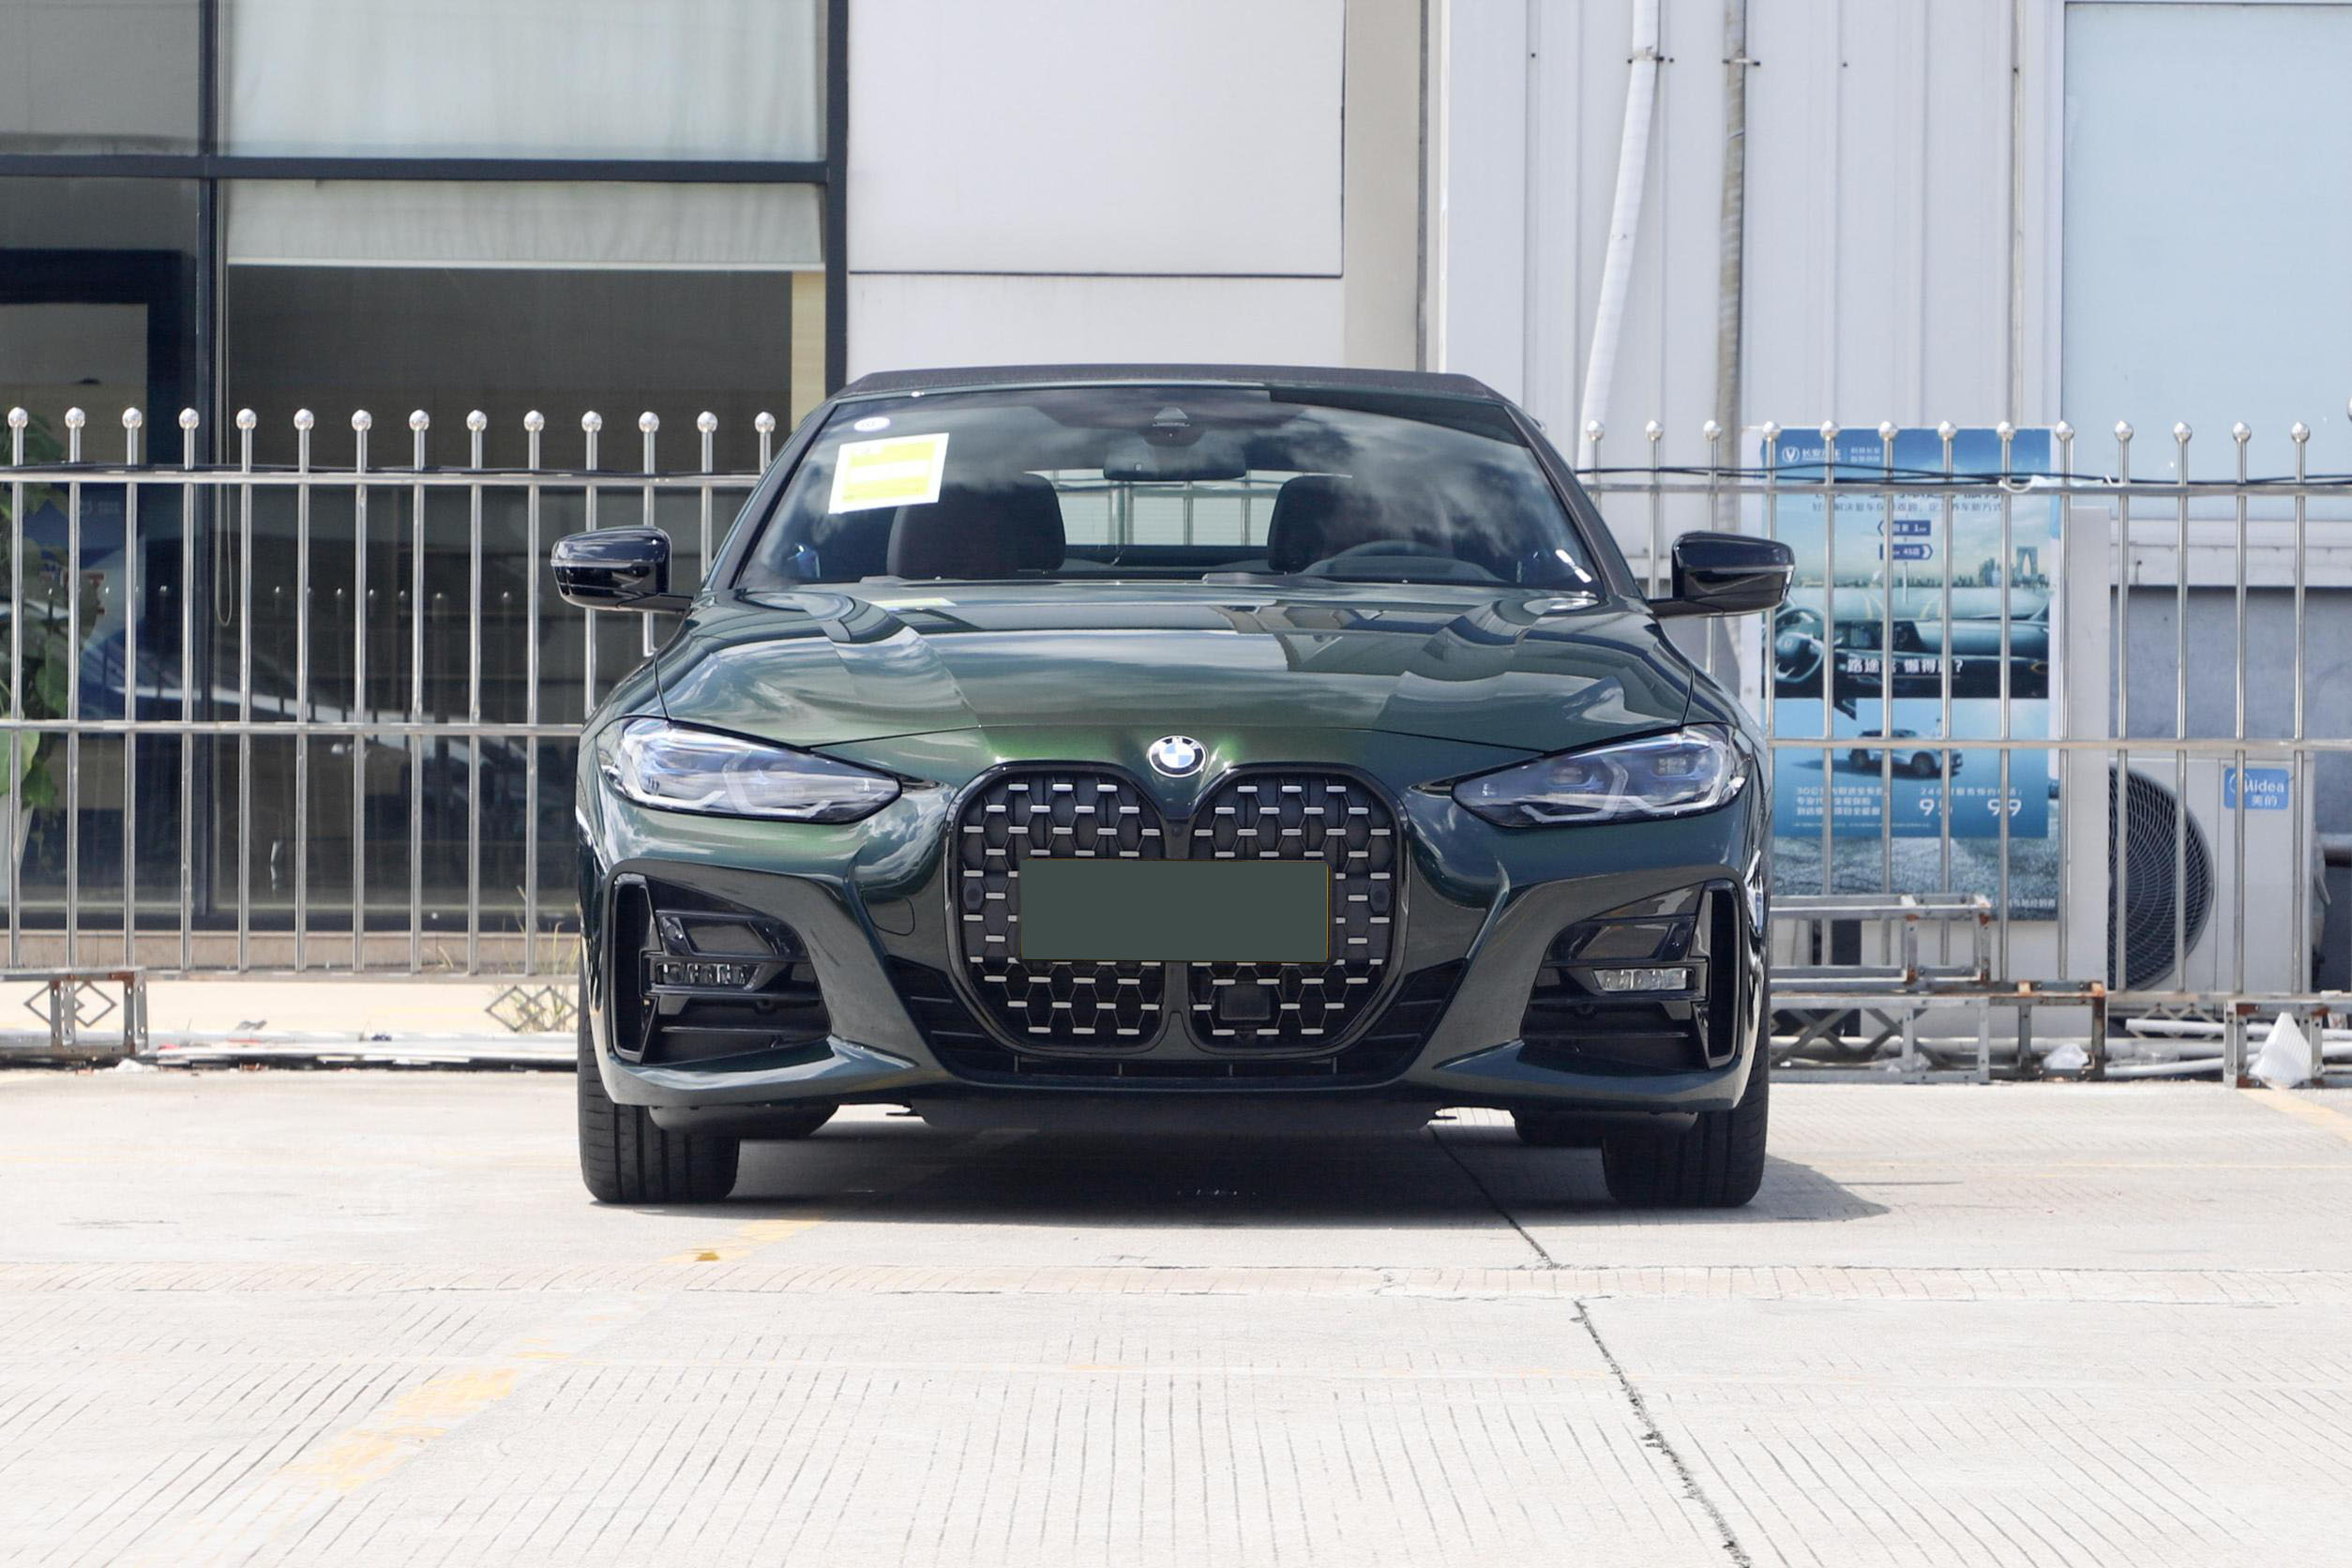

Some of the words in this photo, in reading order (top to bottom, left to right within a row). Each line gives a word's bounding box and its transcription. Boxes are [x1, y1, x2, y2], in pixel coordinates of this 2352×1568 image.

[1802, 448, 1842, 458] 长安车
[1847, 658, 1896, 673] 路途
